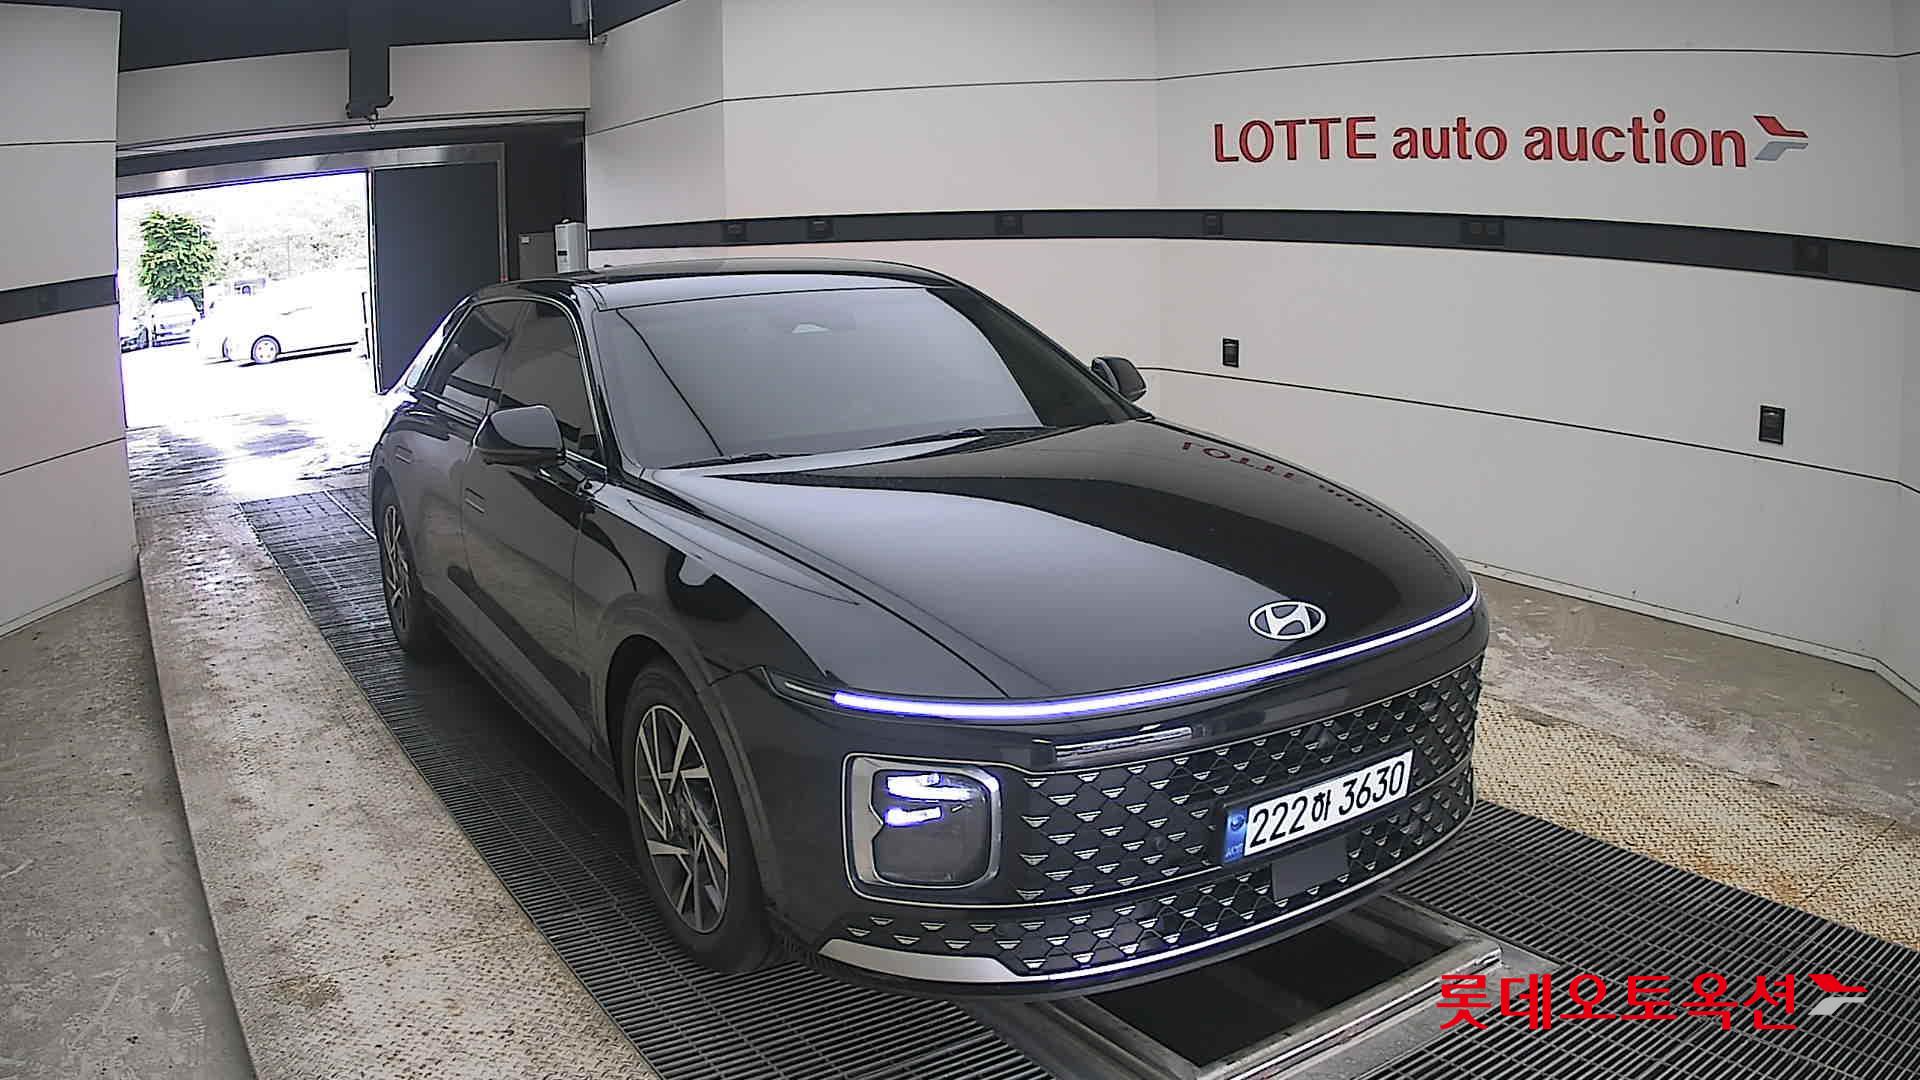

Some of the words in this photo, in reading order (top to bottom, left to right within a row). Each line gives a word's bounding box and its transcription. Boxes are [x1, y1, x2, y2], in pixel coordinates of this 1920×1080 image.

[1213, 116, 1377, 163] LOTTE
[1392, 117, 1509, 160] auto
[1523, 109, 1747, 167] auction
[1249, 789, 1332, 849] 222하
[1338, 760, 1405, 816] 3630
